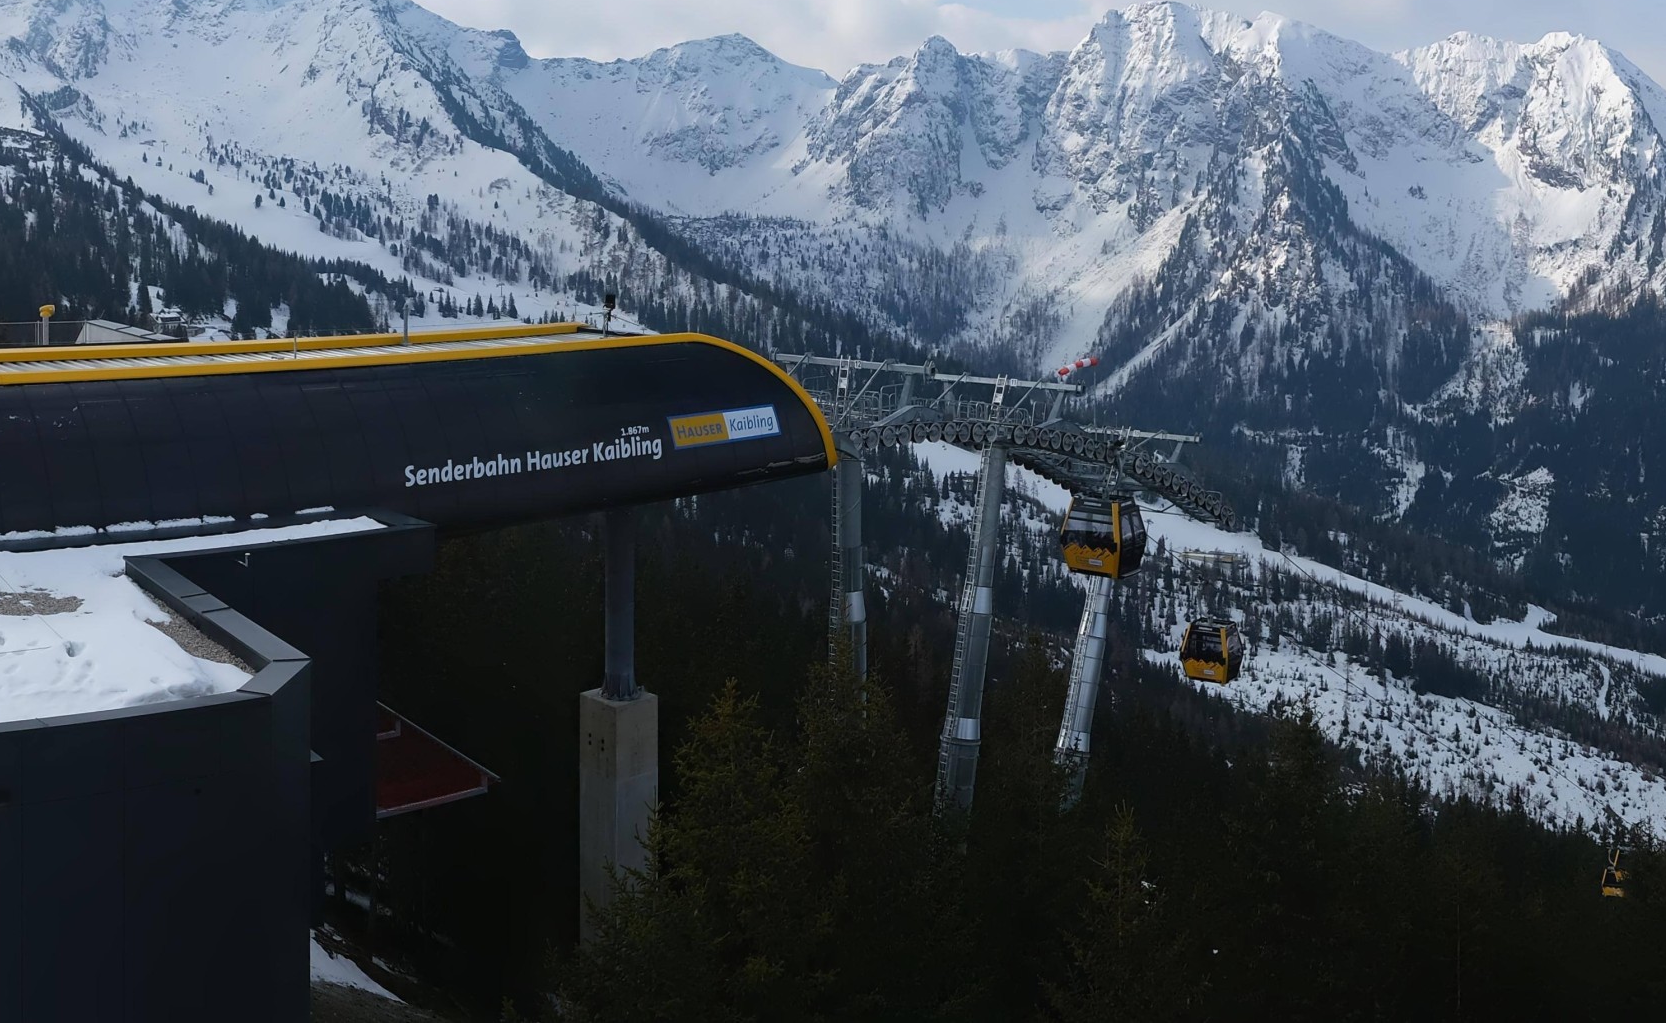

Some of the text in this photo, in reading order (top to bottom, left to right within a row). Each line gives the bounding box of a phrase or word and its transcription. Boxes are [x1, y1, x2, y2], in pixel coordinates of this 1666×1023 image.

[854, 360, 862, 368] 12
[620, 426, 650, 436] 1.867m
[676, 413, 774, 440] HAUSER Kaibling
[404, 436, 663, 487] Senderbahn Hauser Kaibling
